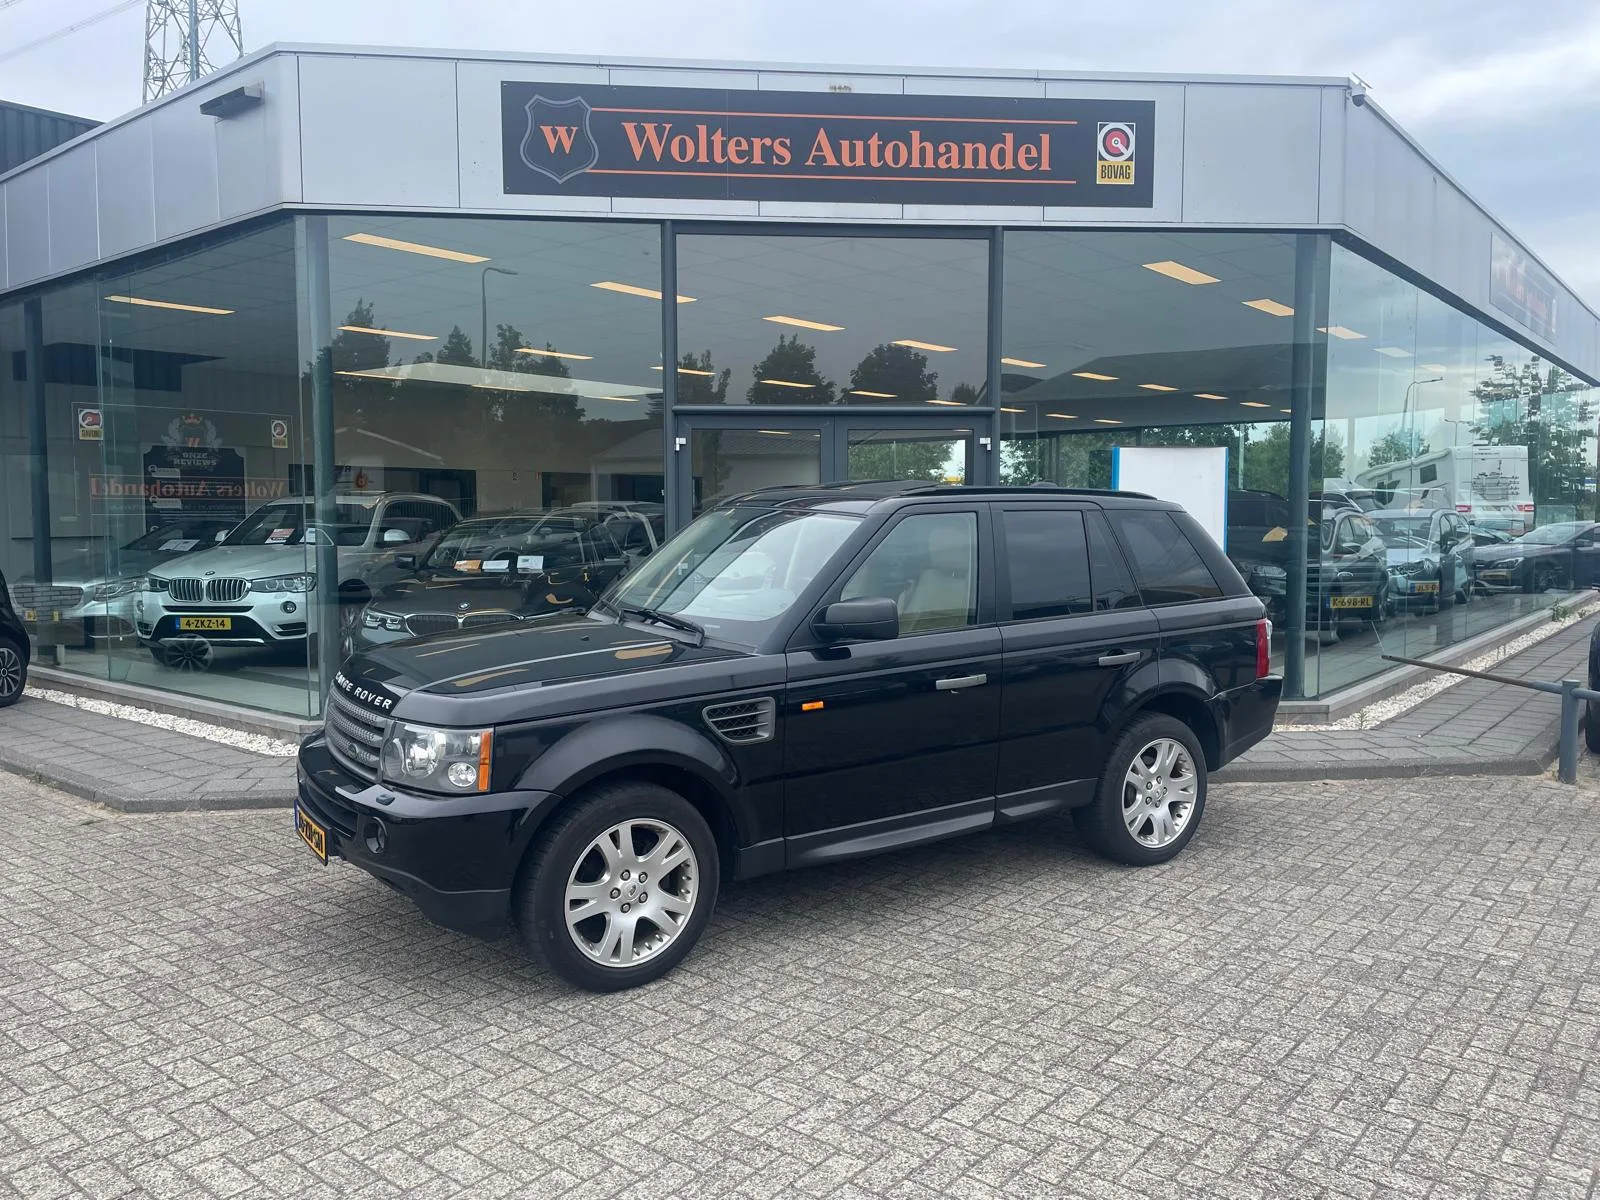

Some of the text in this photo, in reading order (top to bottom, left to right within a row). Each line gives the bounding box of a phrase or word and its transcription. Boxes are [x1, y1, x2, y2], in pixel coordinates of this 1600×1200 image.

[540, 125, 579, 154] W
[621, 122, 1052, 171] Wolters Autohandel
[1100, 164, 1131, 180] BOVAG
[173, 458, 218, 467] REVIEWS
[1332, 597, 1371, 607] K-698-RL
[185, 619, 226, 629] 4-ZKZ-14
[353, 686, 393, 710] ROVER
